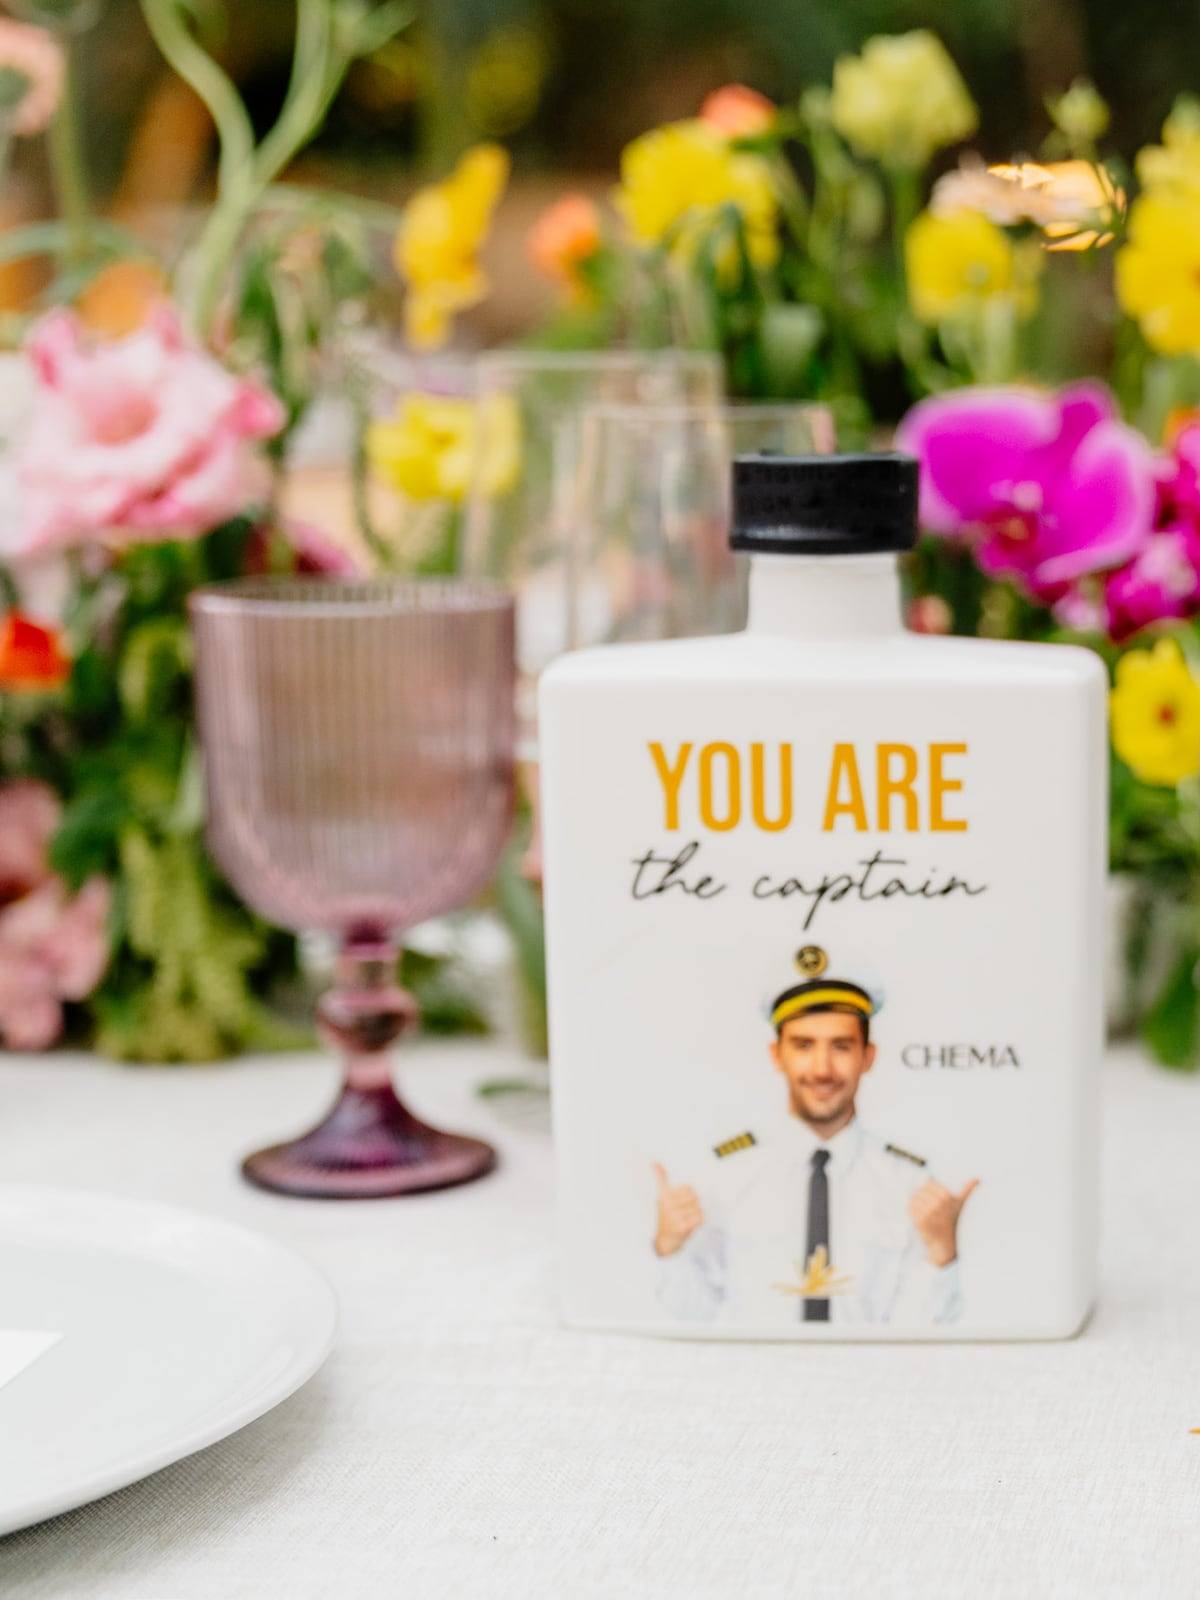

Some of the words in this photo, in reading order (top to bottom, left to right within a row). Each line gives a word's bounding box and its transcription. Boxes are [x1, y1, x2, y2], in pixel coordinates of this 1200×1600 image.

[647, 741, 793, 833] YOU
[821, 741, 969, 833] ARE
[630, 840, 728, 901] the
[751, 850, 988, 931] captain
[899, 1042, 1021, 1071] CHEMA
